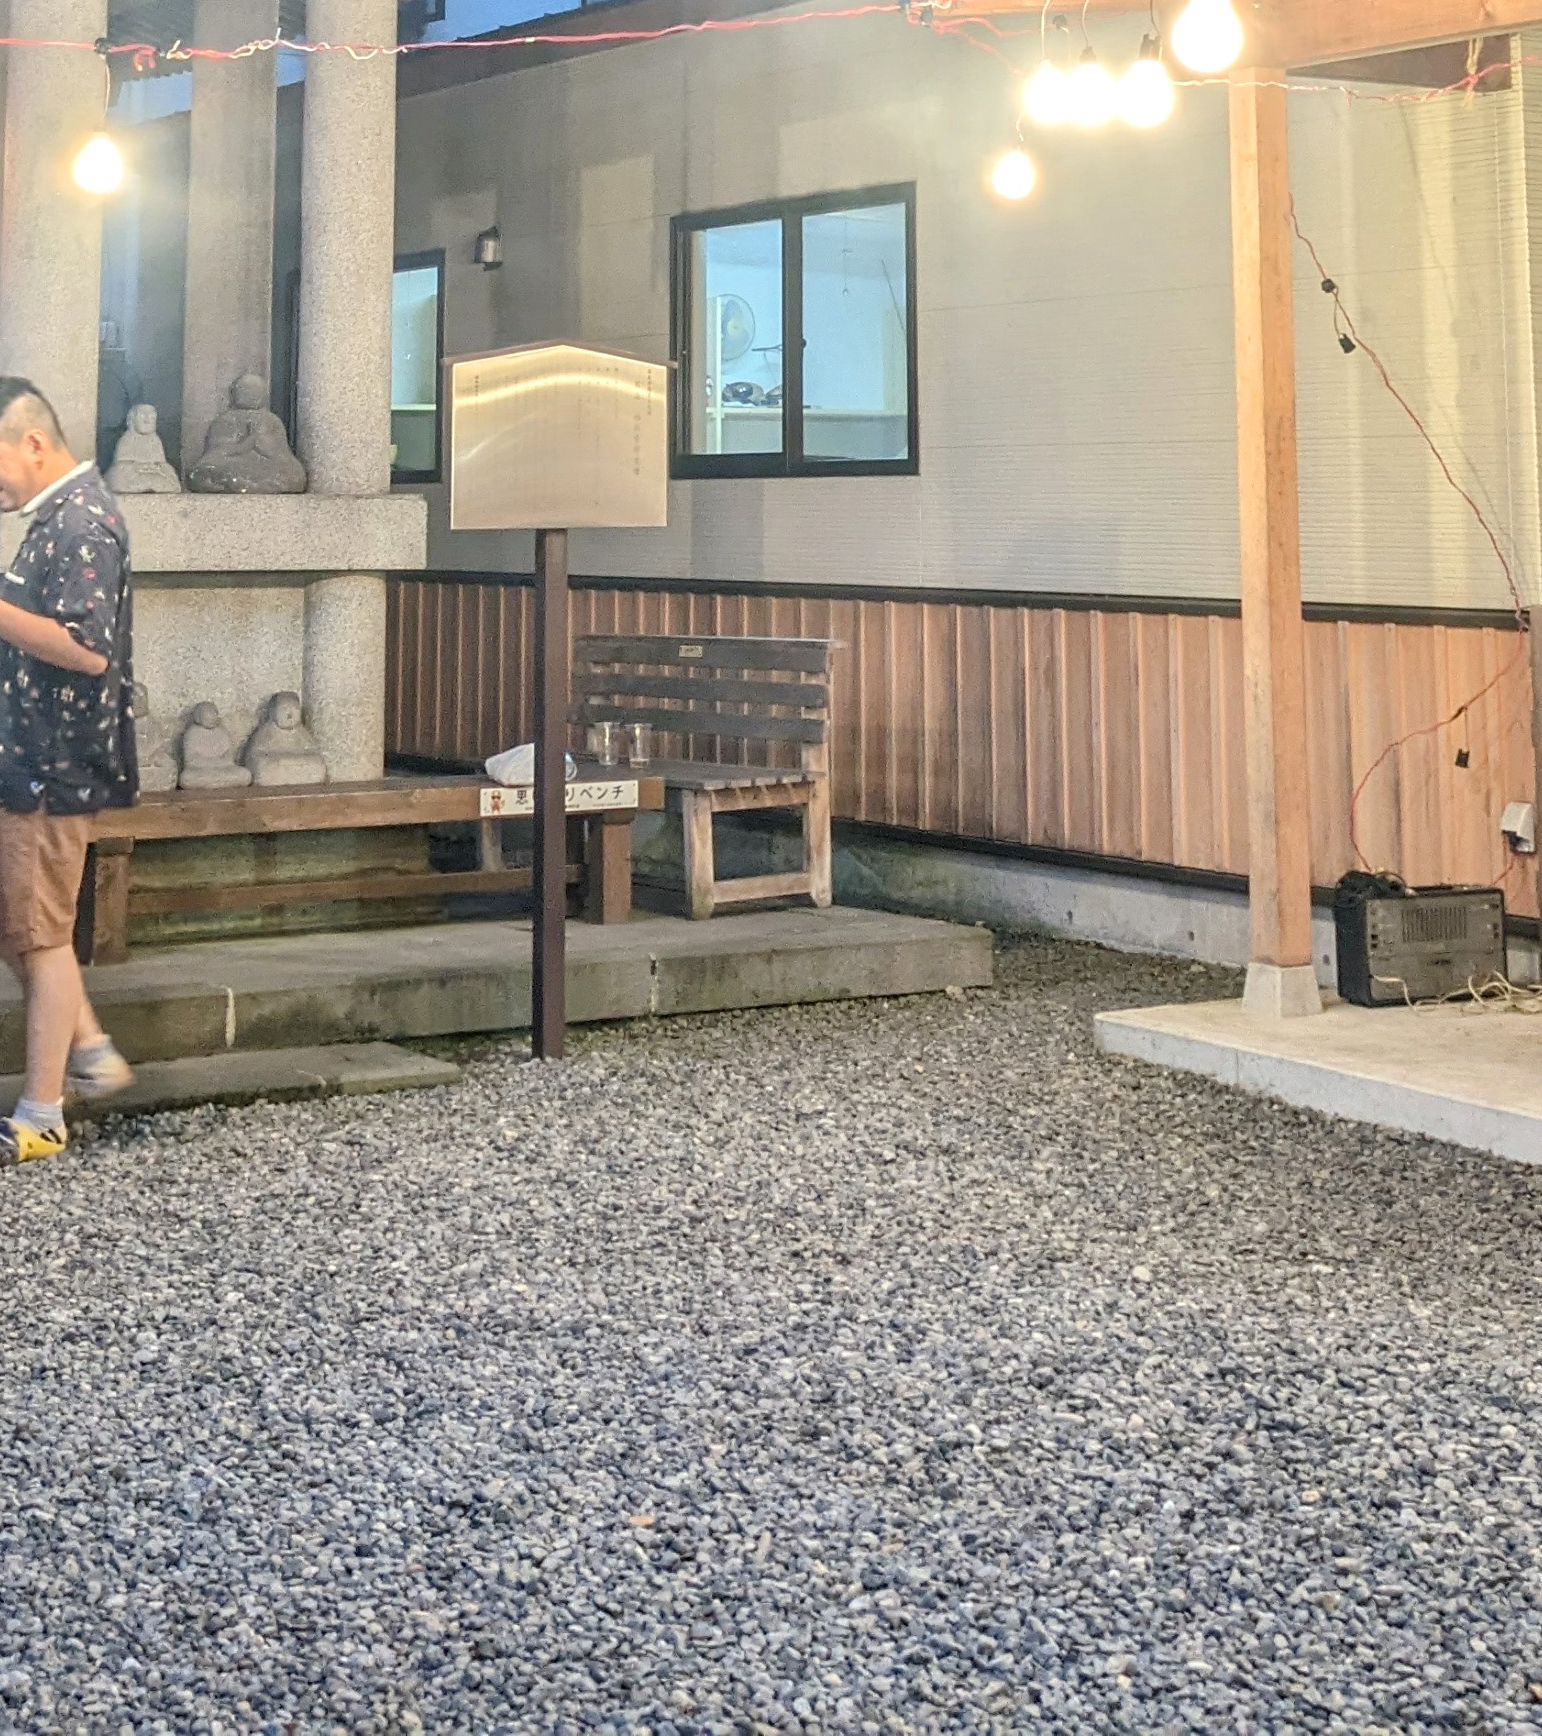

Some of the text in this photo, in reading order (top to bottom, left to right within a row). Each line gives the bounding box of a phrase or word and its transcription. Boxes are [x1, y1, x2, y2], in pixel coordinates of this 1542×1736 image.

[515, 784, 624, 806] 思りベンチ
